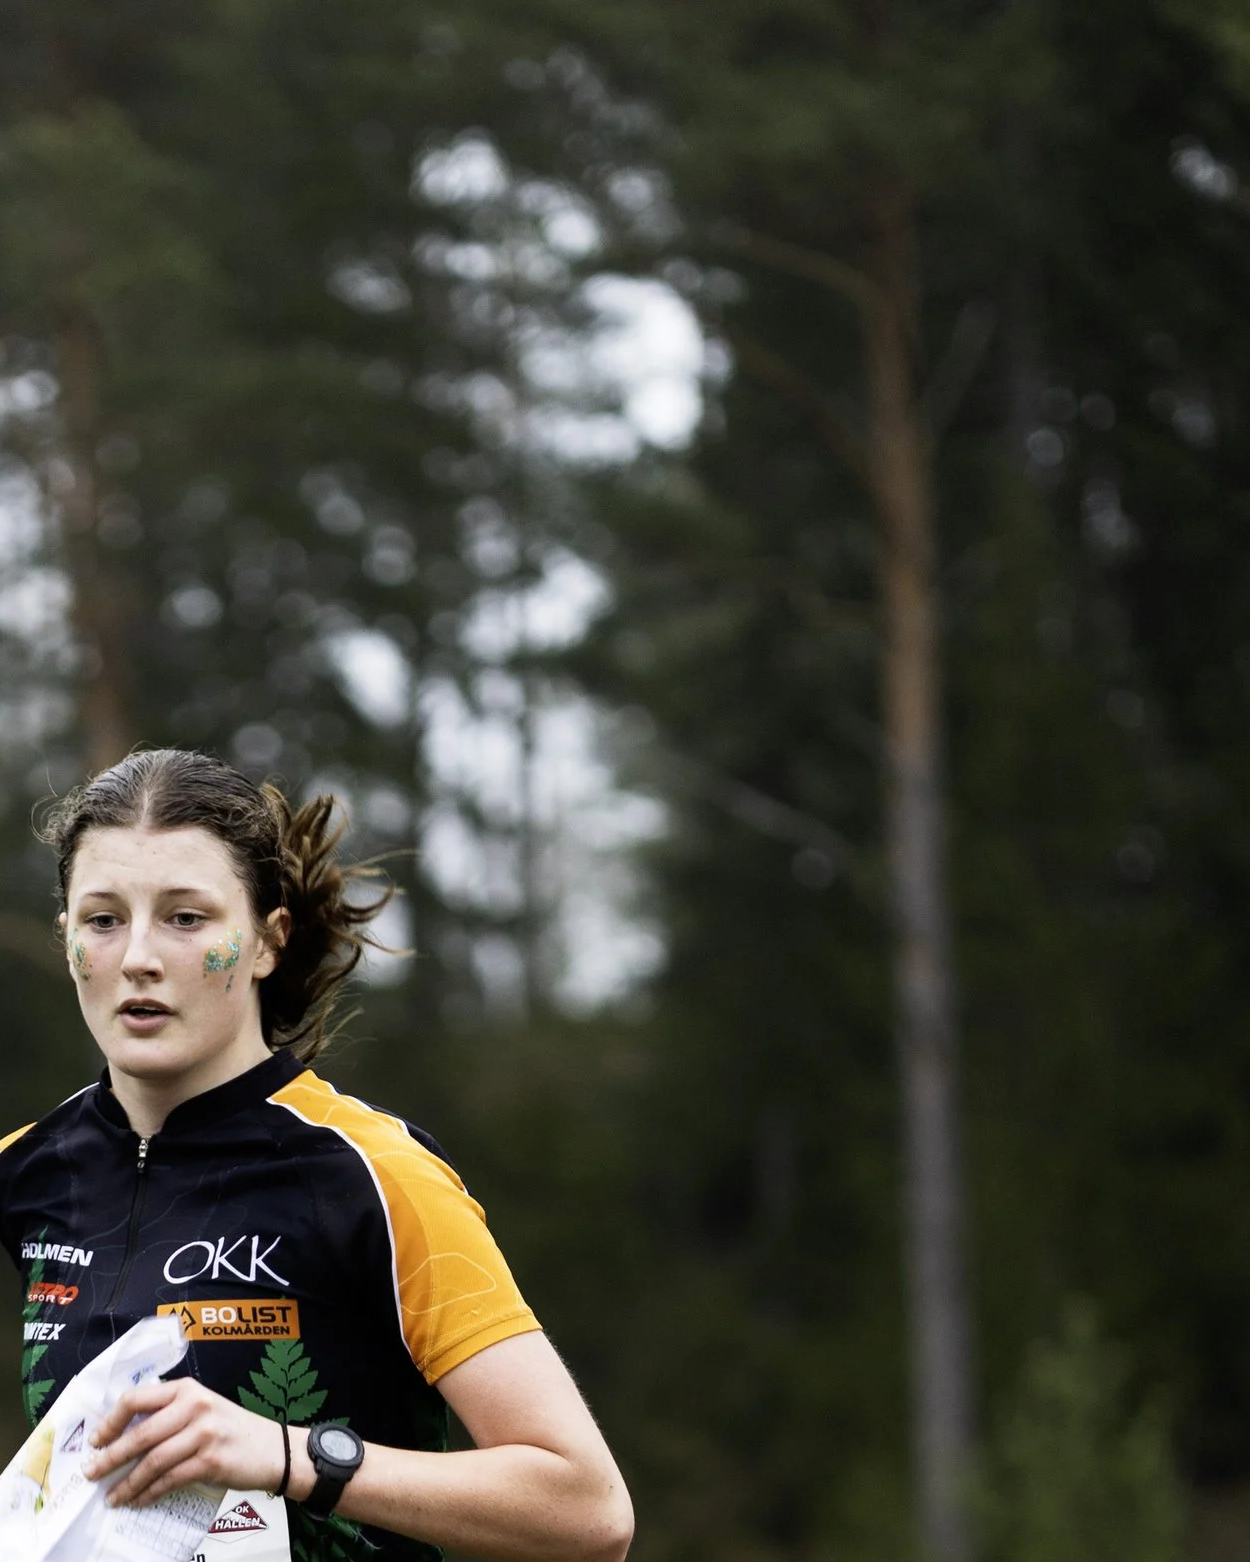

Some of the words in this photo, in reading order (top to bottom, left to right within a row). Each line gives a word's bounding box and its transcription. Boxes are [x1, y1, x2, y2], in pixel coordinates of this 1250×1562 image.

[21, 1242, 94, 1267] HOLMEN
[163, 1235, 290, 1286] OKK
[28, 1294, 74, 1305] SPORT
[200, 1305, 292, 1326] BOLIST
[202, 1324, 291, 1336] KOLMÅRDEN
[235, 1505, 250, 1514] OK
